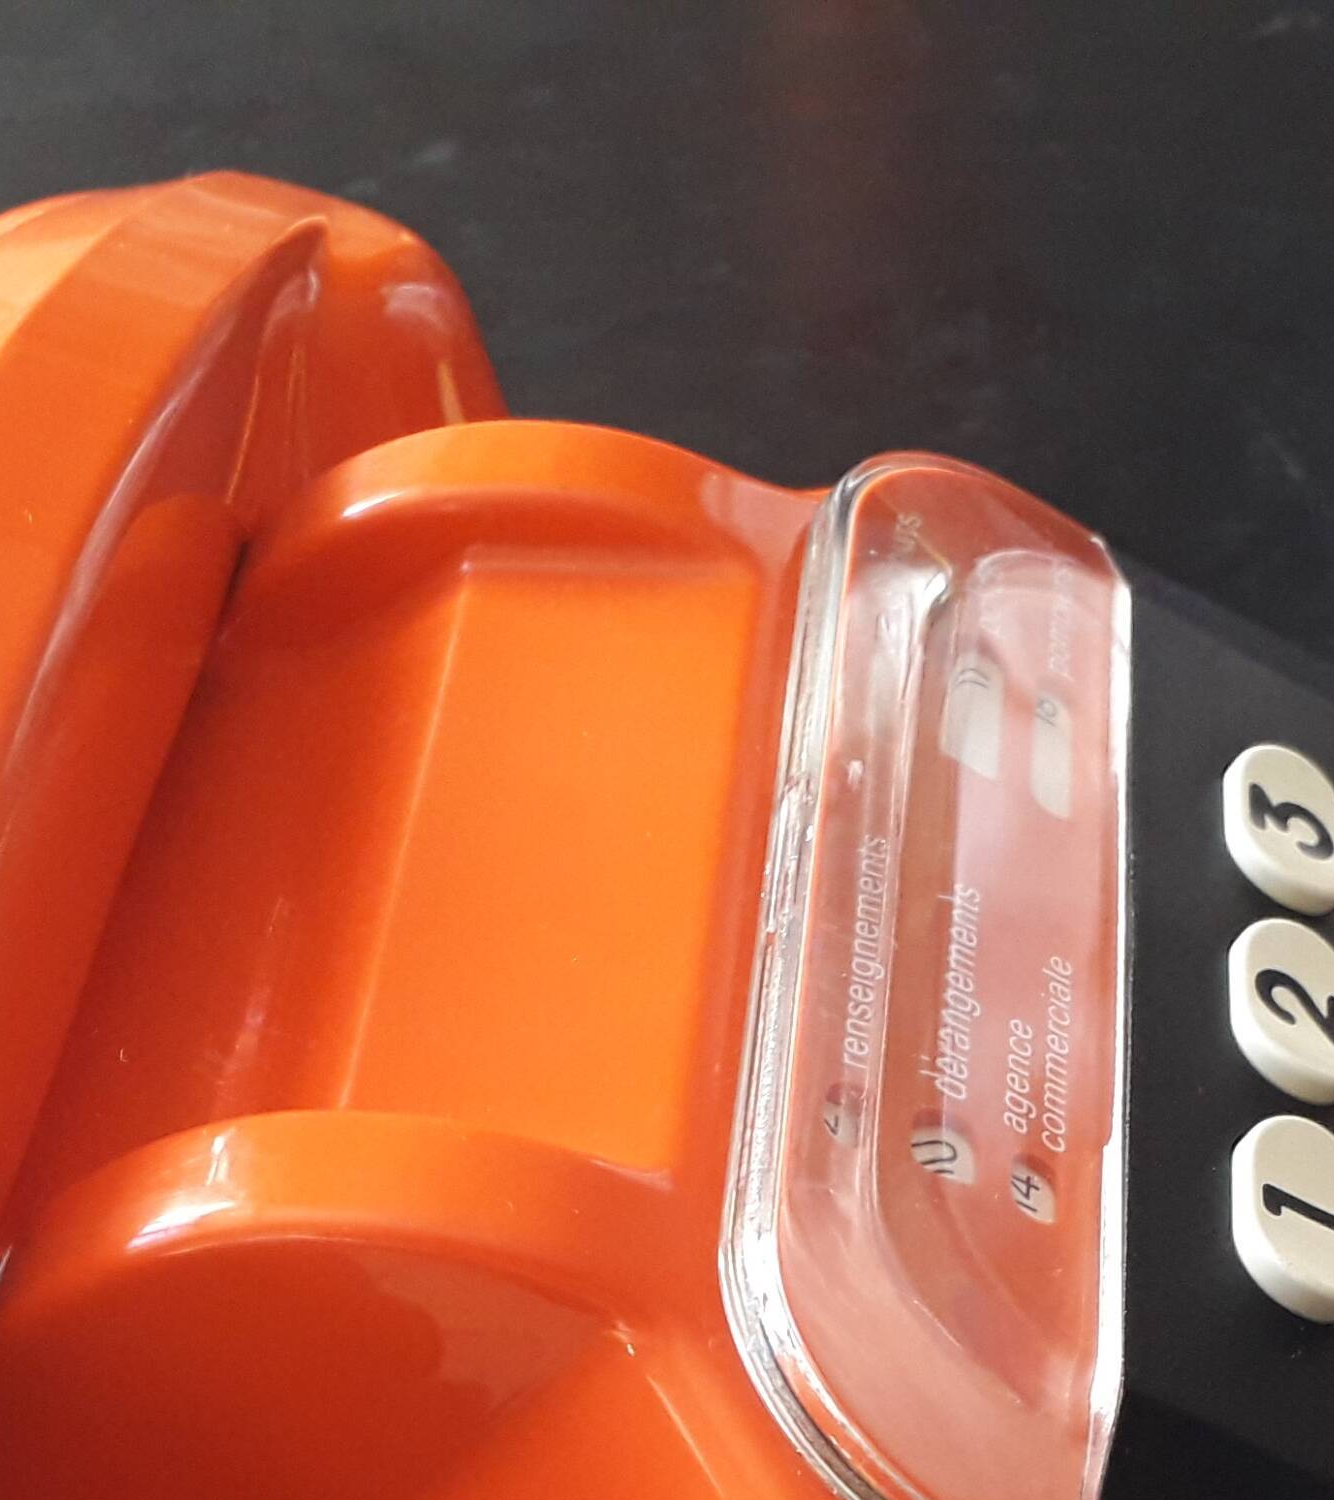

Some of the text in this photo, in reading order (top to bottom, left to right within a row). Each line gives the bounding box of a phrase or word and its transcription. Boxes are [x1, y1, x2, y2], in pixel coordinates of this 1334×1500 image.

[841, 834, 890, 1070] renseignements
[918, 883, 981, 1101] dérangements
[1040, 955, 1074, 1153] commerciale
[1002, 1018, 1037, 1135] agence
